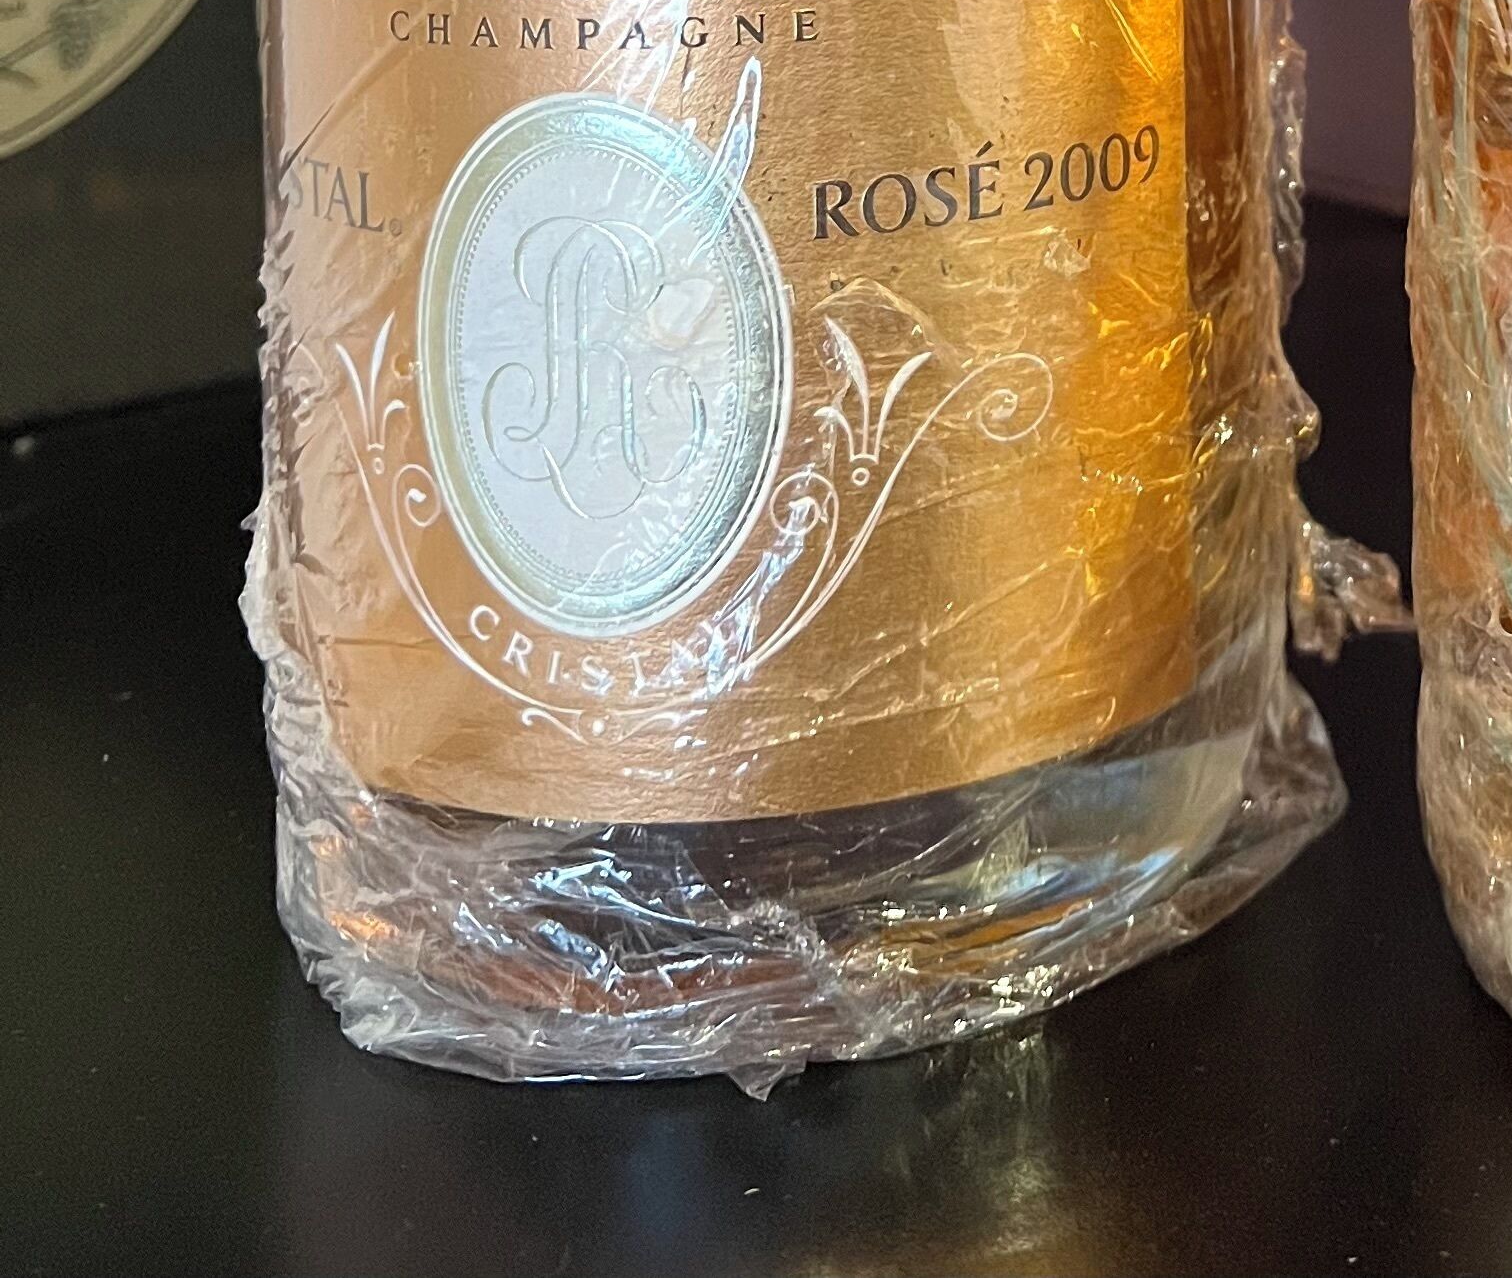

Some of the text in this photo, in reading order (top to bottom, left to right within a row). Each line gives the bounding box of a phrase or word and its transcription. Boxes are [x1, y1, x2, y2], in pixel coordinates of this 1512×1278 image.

[390, 9, 819, 50] CHAMPAGNE
[812, 124, 1160, 241] ROSÉ 2009
